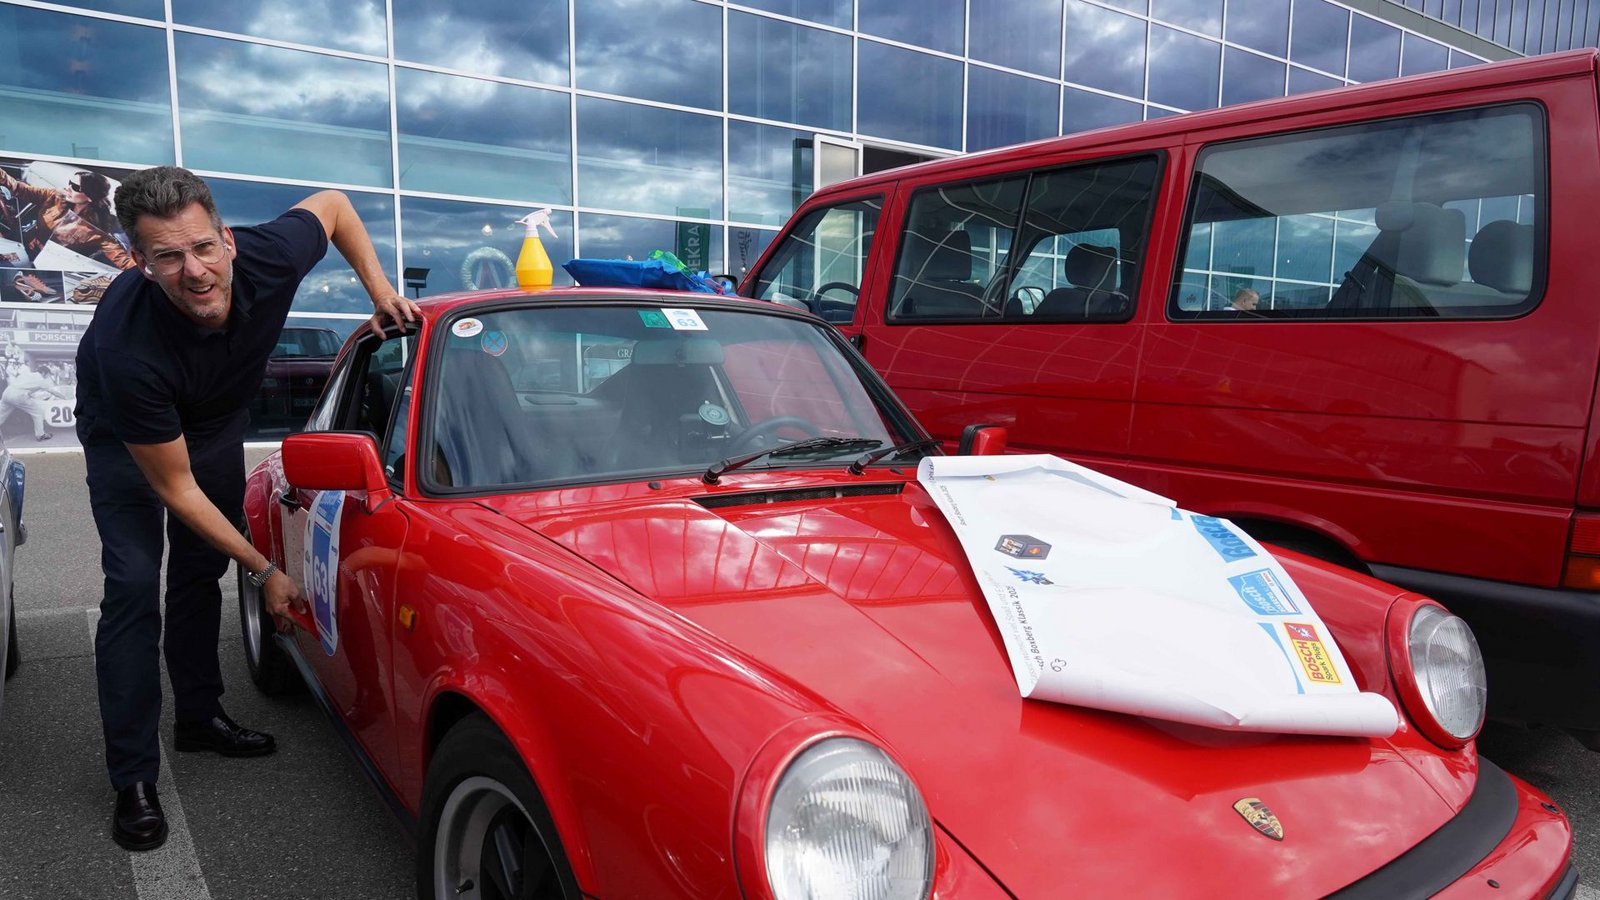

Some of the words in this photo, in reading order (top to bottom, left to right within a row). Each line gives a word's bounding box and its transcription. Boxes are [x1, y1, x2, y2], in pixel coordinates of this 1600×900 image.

[676, 318, 698, 327] 63
[34, 333, 78, 342] PORSCHE
[51, 406, 73, 423] 20
[313, 555, 329, 604] 63
[1012, 600, 1028, 625] Klassik
[1023, 625, 1040, 654] Boxberg
[1296, 641, 1325, 680] BOSCH
[1310, 642, 1324, 661] Plugs
[1320, 661, 1334, 681] Spark
